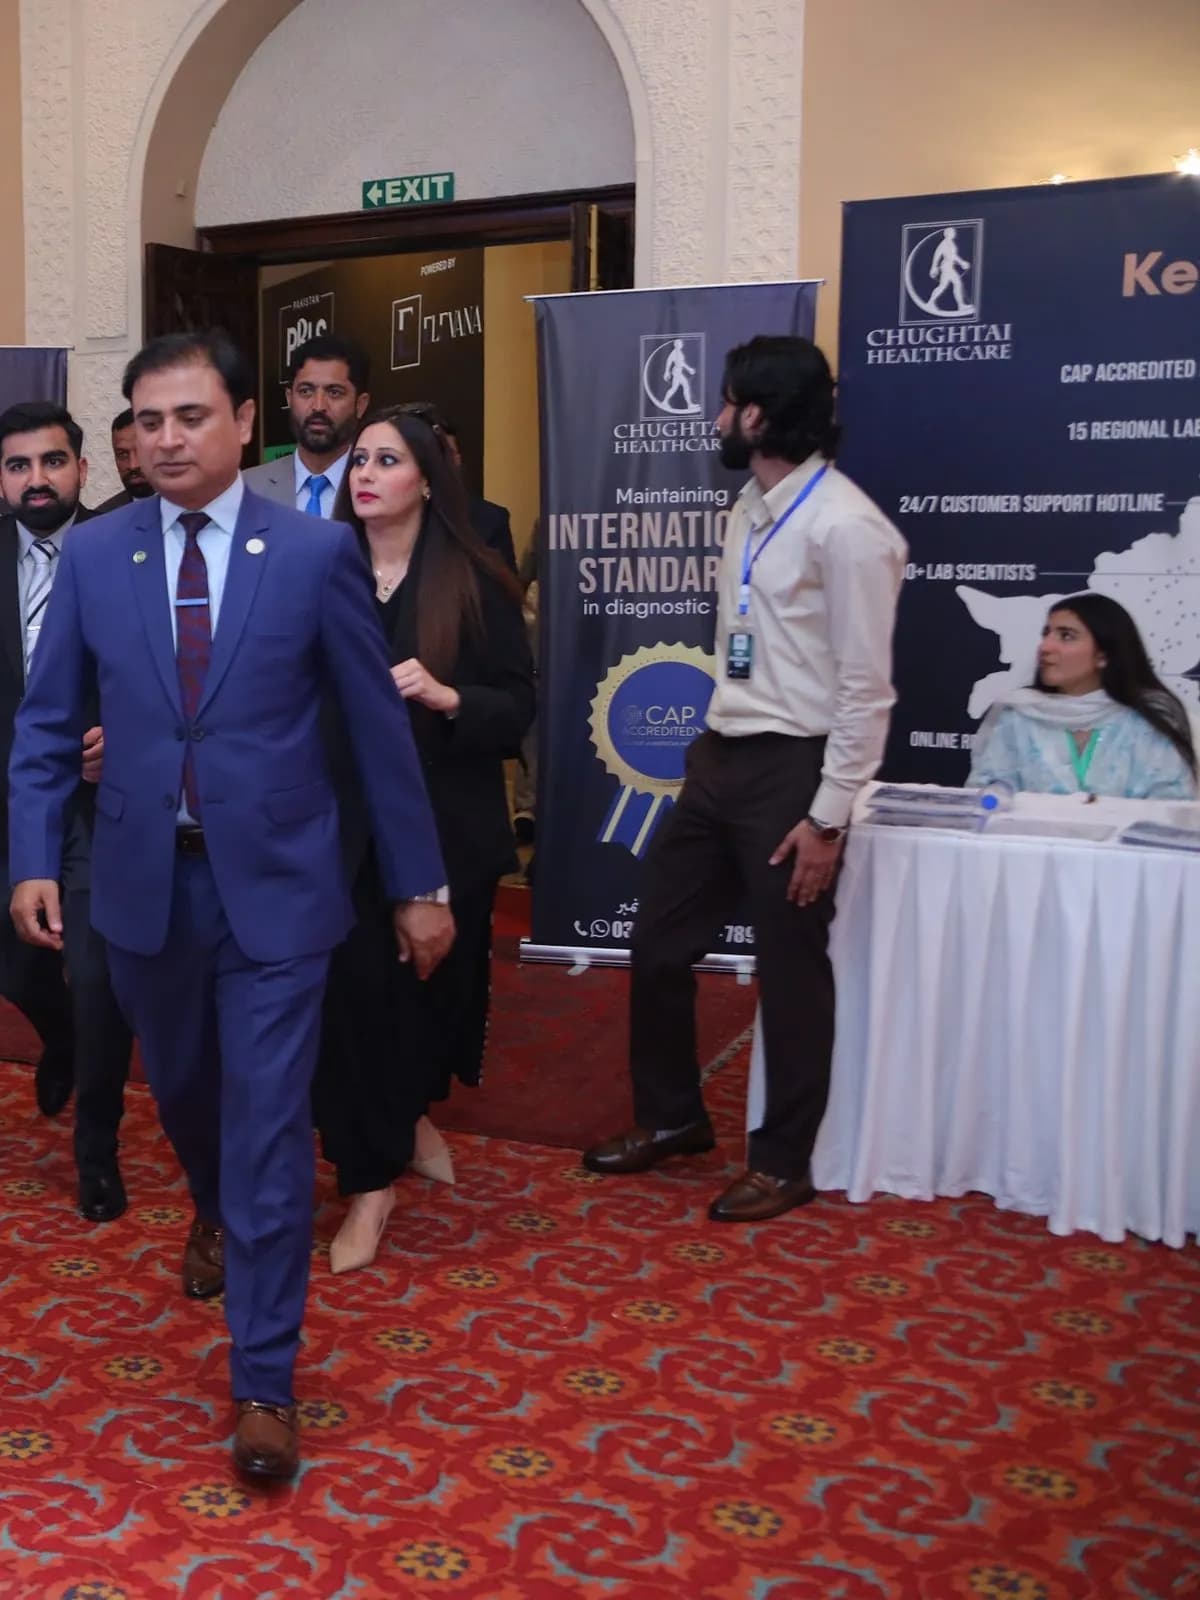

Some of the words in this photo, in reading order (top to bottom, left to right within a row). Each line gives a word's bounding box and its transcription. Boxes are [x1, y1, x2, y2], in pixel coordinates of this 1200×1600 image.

[385, 175, 451, 204] EXIT
[1123, 251, 1200, 297] Ke
[866, 323, 1013, 347] CHUGHTAI
[867, 344, 1013, 364] HEALTHCARE
[1060, 364, 1093, 383] CAP
[1095, 360, 1196, 382] ACCREDITED
[613, 421, 721, 439] CHUGHTA
[1067, 422, 1089, 441] 15
[1090, 419, 1169, 440] REGIONAL
[614, 437, 722, 454] HEALTHCAR
[616, 486, 729, 506] Maintaining
[899, 496, 938, 513] 24/7
[940, 495, 1021, 513] CUSTOMER
[1024, 494, 1092, 512] SUPPORT
[1096, 493, 1166, 512] HOTLINE
[549, 510, 731, 550] INTERNATIO
[578, 556, 721, 594] STANDAR
[904, 563, 925, 581] 0+
[926, 563, 954, 580] LAB
[955, 563, 1037, 581] SCIENTISTS
[583, 599, 599, 616] in
[605, 598, 711, 619] diagnostic
[645, 705, 696, 725] CAP
[910, 731, 960, 749] ONLINE
